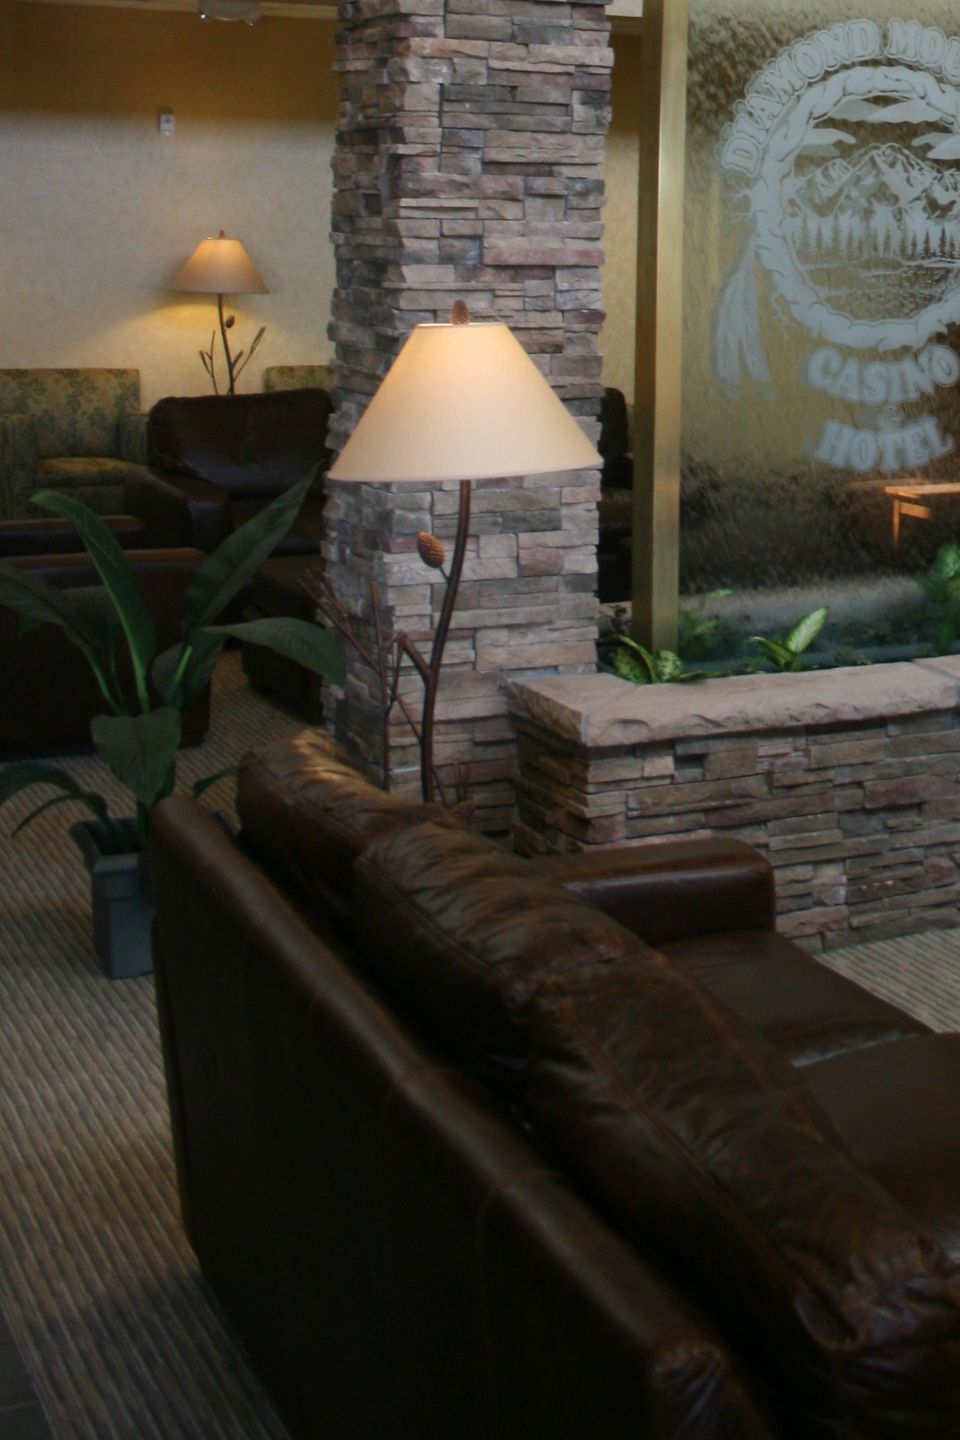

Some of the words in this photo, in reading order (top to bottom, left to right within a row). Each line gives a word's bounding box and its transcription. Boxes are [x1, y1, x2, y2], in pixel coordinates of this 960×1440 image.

[721, 19, 881, 177] DIAMOND
[807, 344, 960, 405] CASINO
[815, 415, 955, 473] HOTEL
